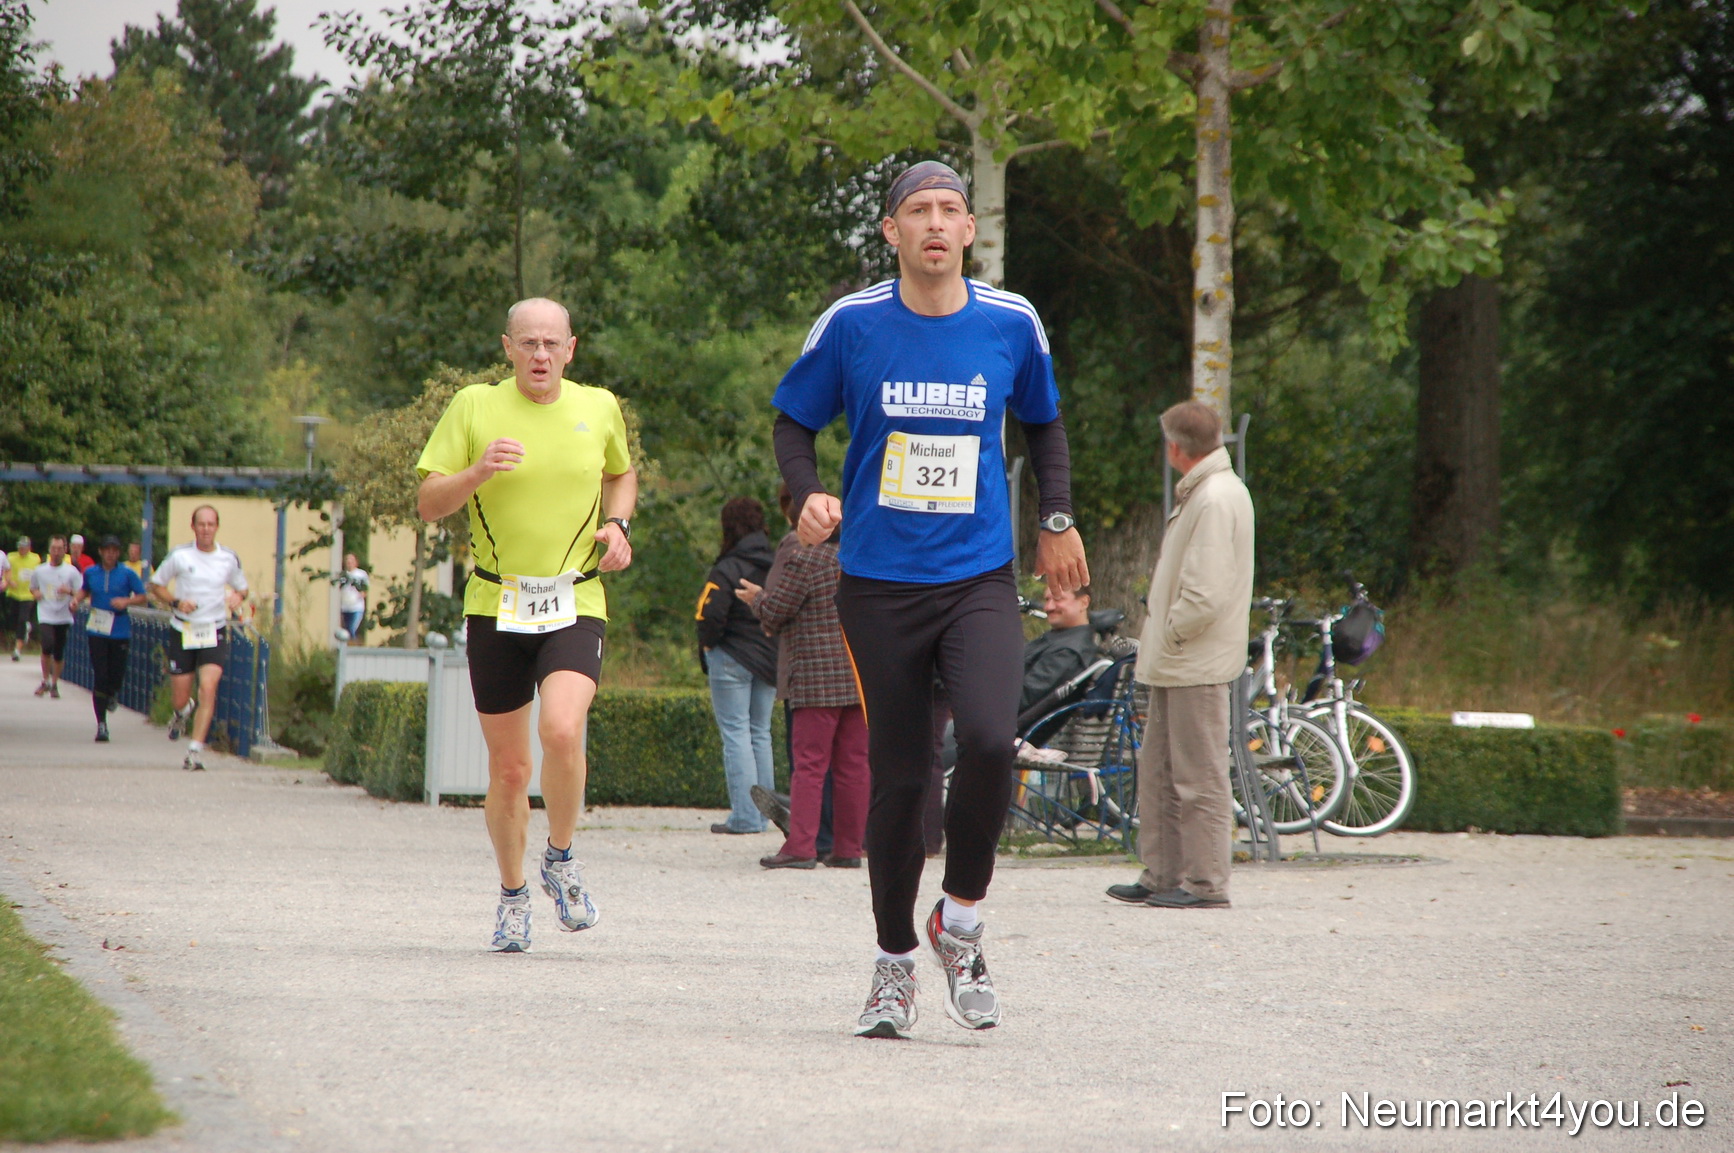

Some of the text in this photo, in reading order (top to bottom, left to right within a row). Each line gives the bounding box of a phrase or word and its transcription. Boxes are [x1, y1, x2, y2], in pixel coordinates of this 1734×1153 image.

[882, 382, 987, 408] HUBER
[904, 406, 981, 418] TECHNOLOGY
[910, 442, 955, 458] Michael
[887, 460, 893, 470] B
[916, 466, 959, 487] 321
[520, 582, 556, 594] Michael
[528, 596, 560, 616] 141
